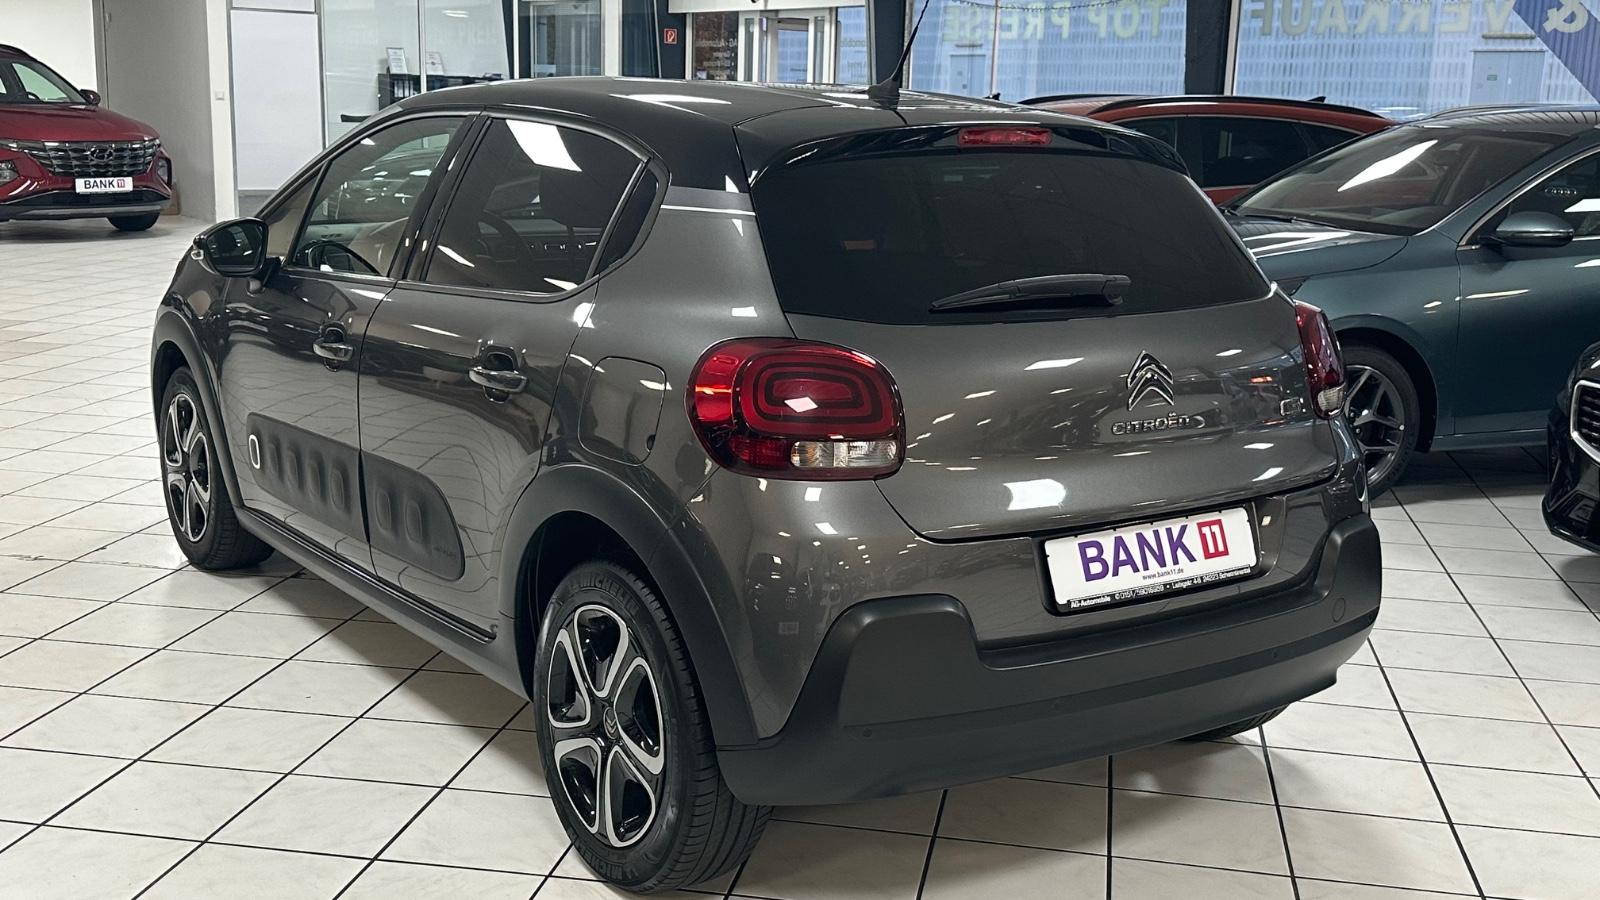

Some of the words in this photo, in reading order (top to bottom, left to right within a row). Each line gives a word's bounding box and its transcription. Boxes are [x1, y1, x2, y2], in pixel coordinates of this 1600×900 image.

[84, 179, 115, 189] BANK
[1078, 524, 1197, 582] BANK
[1200, 523, 1225, 556] 11
[1142, 568, 1184, 580] www.bank11.de
